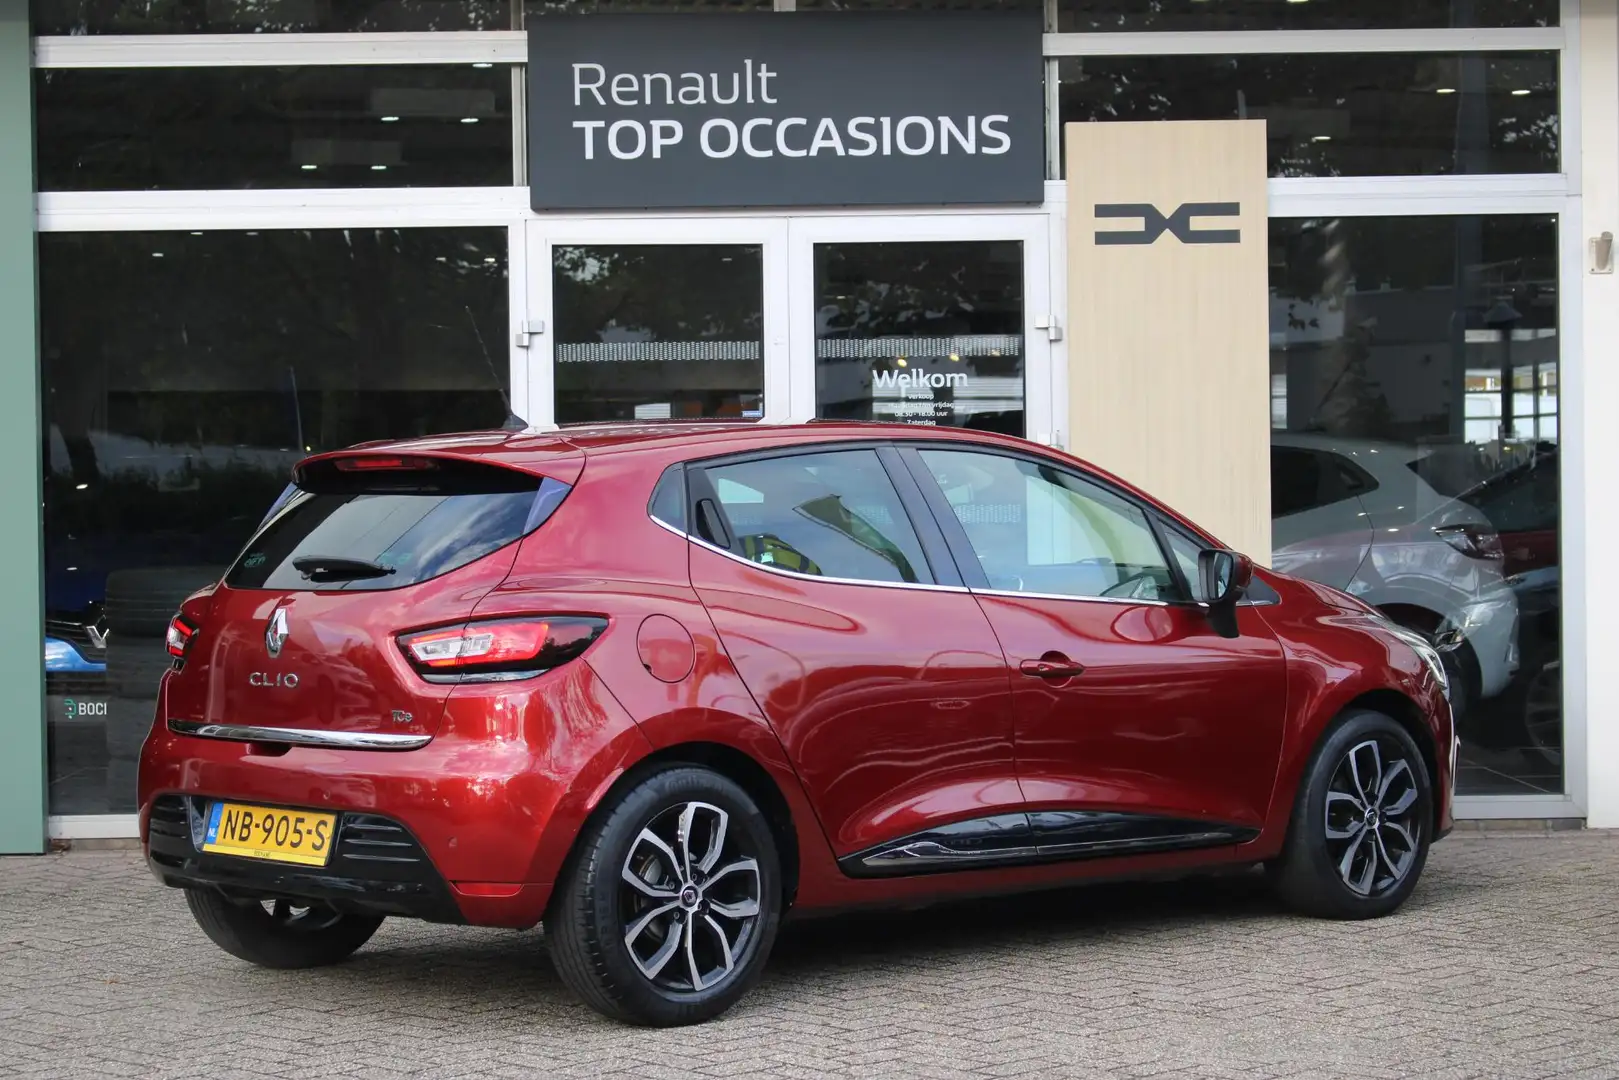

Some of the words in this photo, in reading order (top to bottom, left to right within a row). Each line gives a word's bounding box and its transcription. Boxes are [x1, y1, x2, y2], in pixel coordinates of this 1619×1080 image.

[572, 58, 778, 106] Renault
[572, 119, 684, 160] TOP
[700, 114, 1012, 159] OCCASIONS
[872, 368, 968, 388] Welkom
[249, 671, 299, 688] CLIO
[223, 809, 329, 851] NB-905-S
